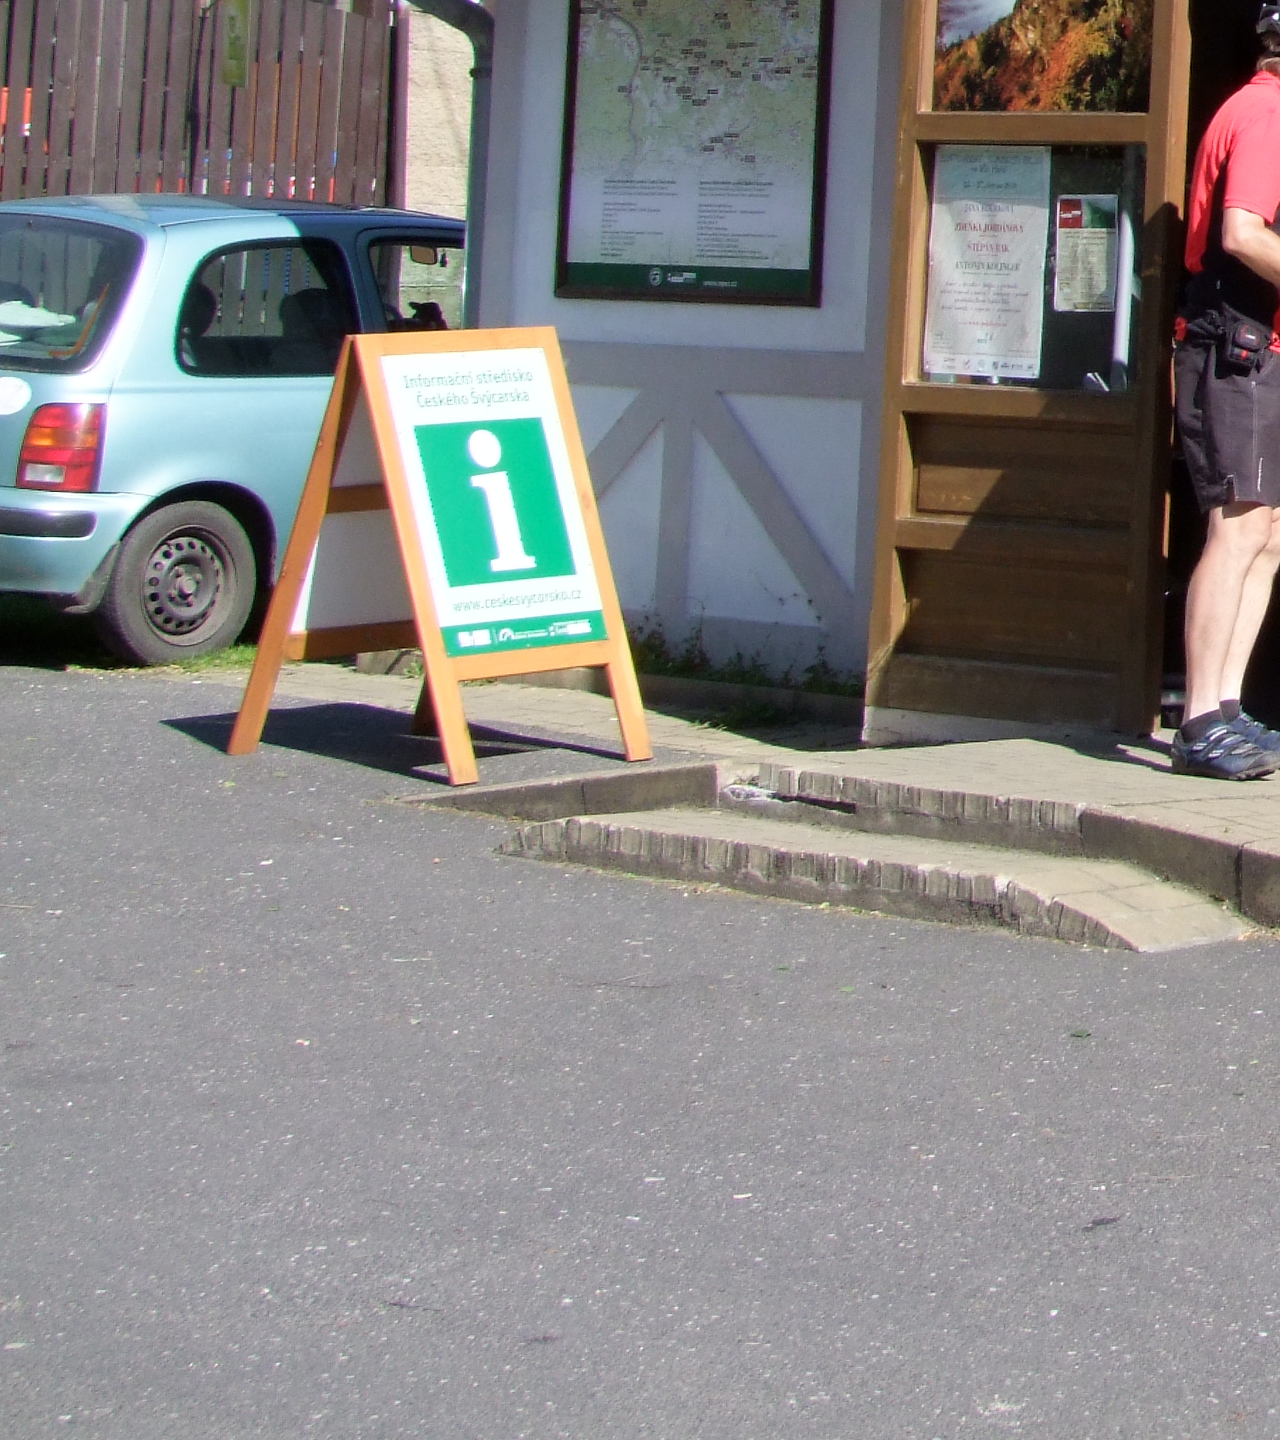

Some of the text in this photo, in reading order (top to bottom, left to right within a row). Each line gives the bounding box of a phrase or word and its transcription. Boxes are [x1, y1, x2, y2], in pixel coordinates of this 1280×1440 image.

[403, 367, 534, 389] Informační středisko
[416, 387, 530, 408] Českého Švýcarska
[452, 589, 582, 612] www.ceskesvycarsko.cz
